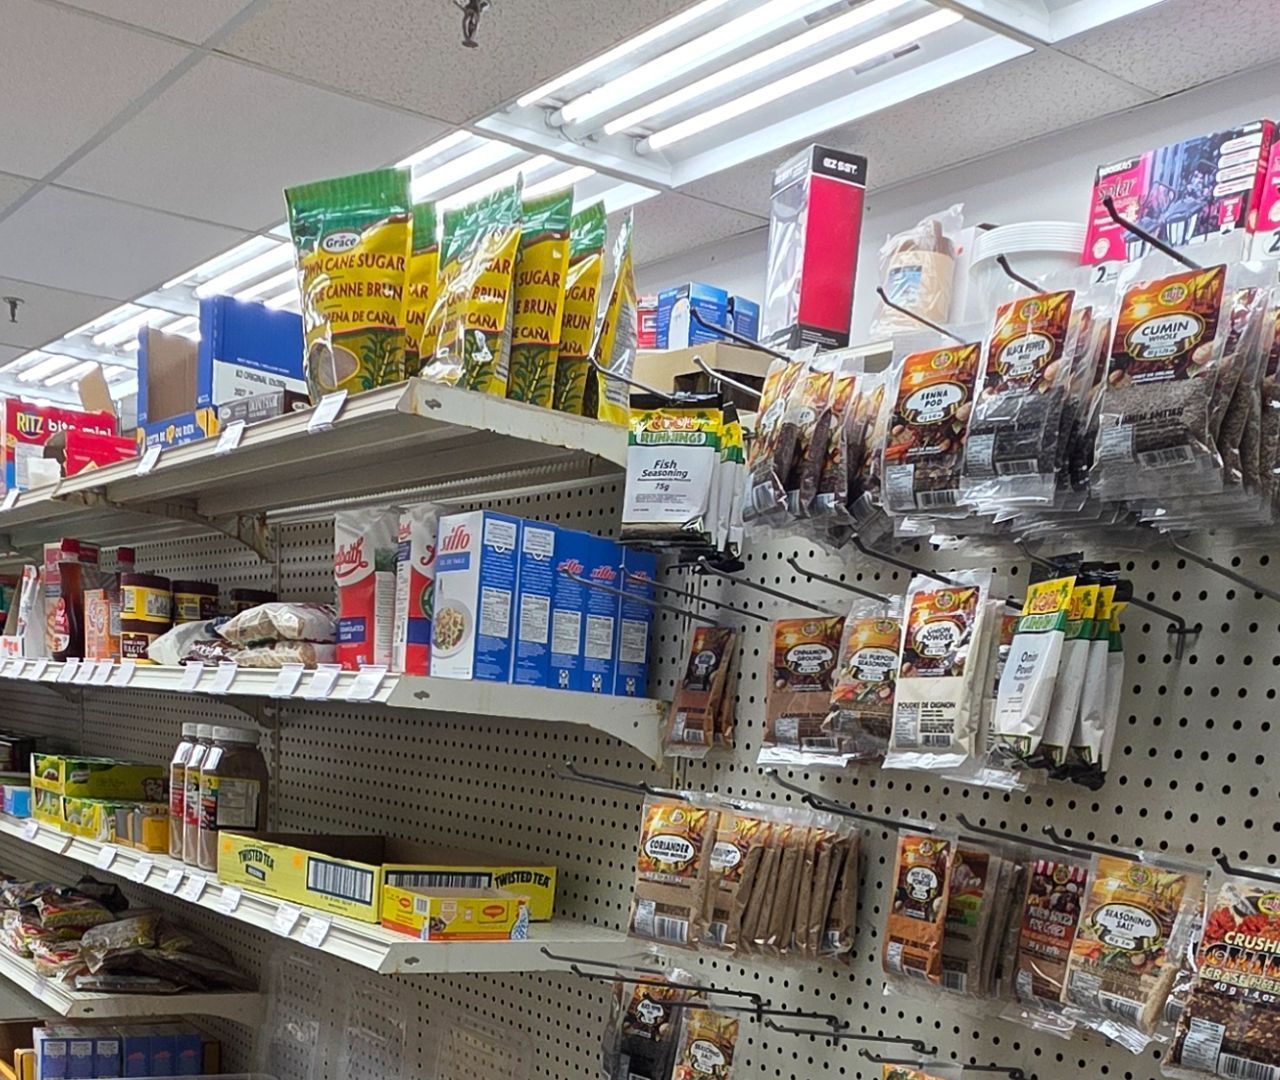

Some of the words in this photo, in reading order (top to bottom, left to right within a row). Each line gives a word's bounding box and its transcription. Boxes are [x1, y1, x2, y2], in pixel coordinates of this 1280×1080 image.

[326, 236, 357, 249] Grace
[325, 255, 354, 271] CANE
[357, 253, 406, 271] SUGAR
[520, 269, 560, 287] SUGAR
[1095, 266, 1107, 283] 2
[326, 281, 362, 298] CANNE
[367, 281, 403, 300] BRUN
[524, 300, 557, 316] BRUN
[352, 310, 364, 322] DE
[366, 309, 397, 326] CAÑA
[468, 312, 498, 330] CAÑA
[521, 327, 550, 341] CAÑA
[1142, 320, 1189, 338] CUMIN
[17, 412, 45, 433] RITZ
[654, 459, 677, 469] Fish
[642, 468, 688, 479] Seasoning
[921, 633, 954, 642] POWDER
[650, 839, 690, 854] CORIANDER
[239, 850, 264, 864] TWISTED
[494, 871, 531, 889] TWISTED
[531, 871, 551, 888] TEA
[1105, 908, 1152, 927] SEASONING
[1115, 919, 1134, 931] SALT
[1213, 981, 1227, 991] 40
[1262, 994, 1276, 1003] oz
